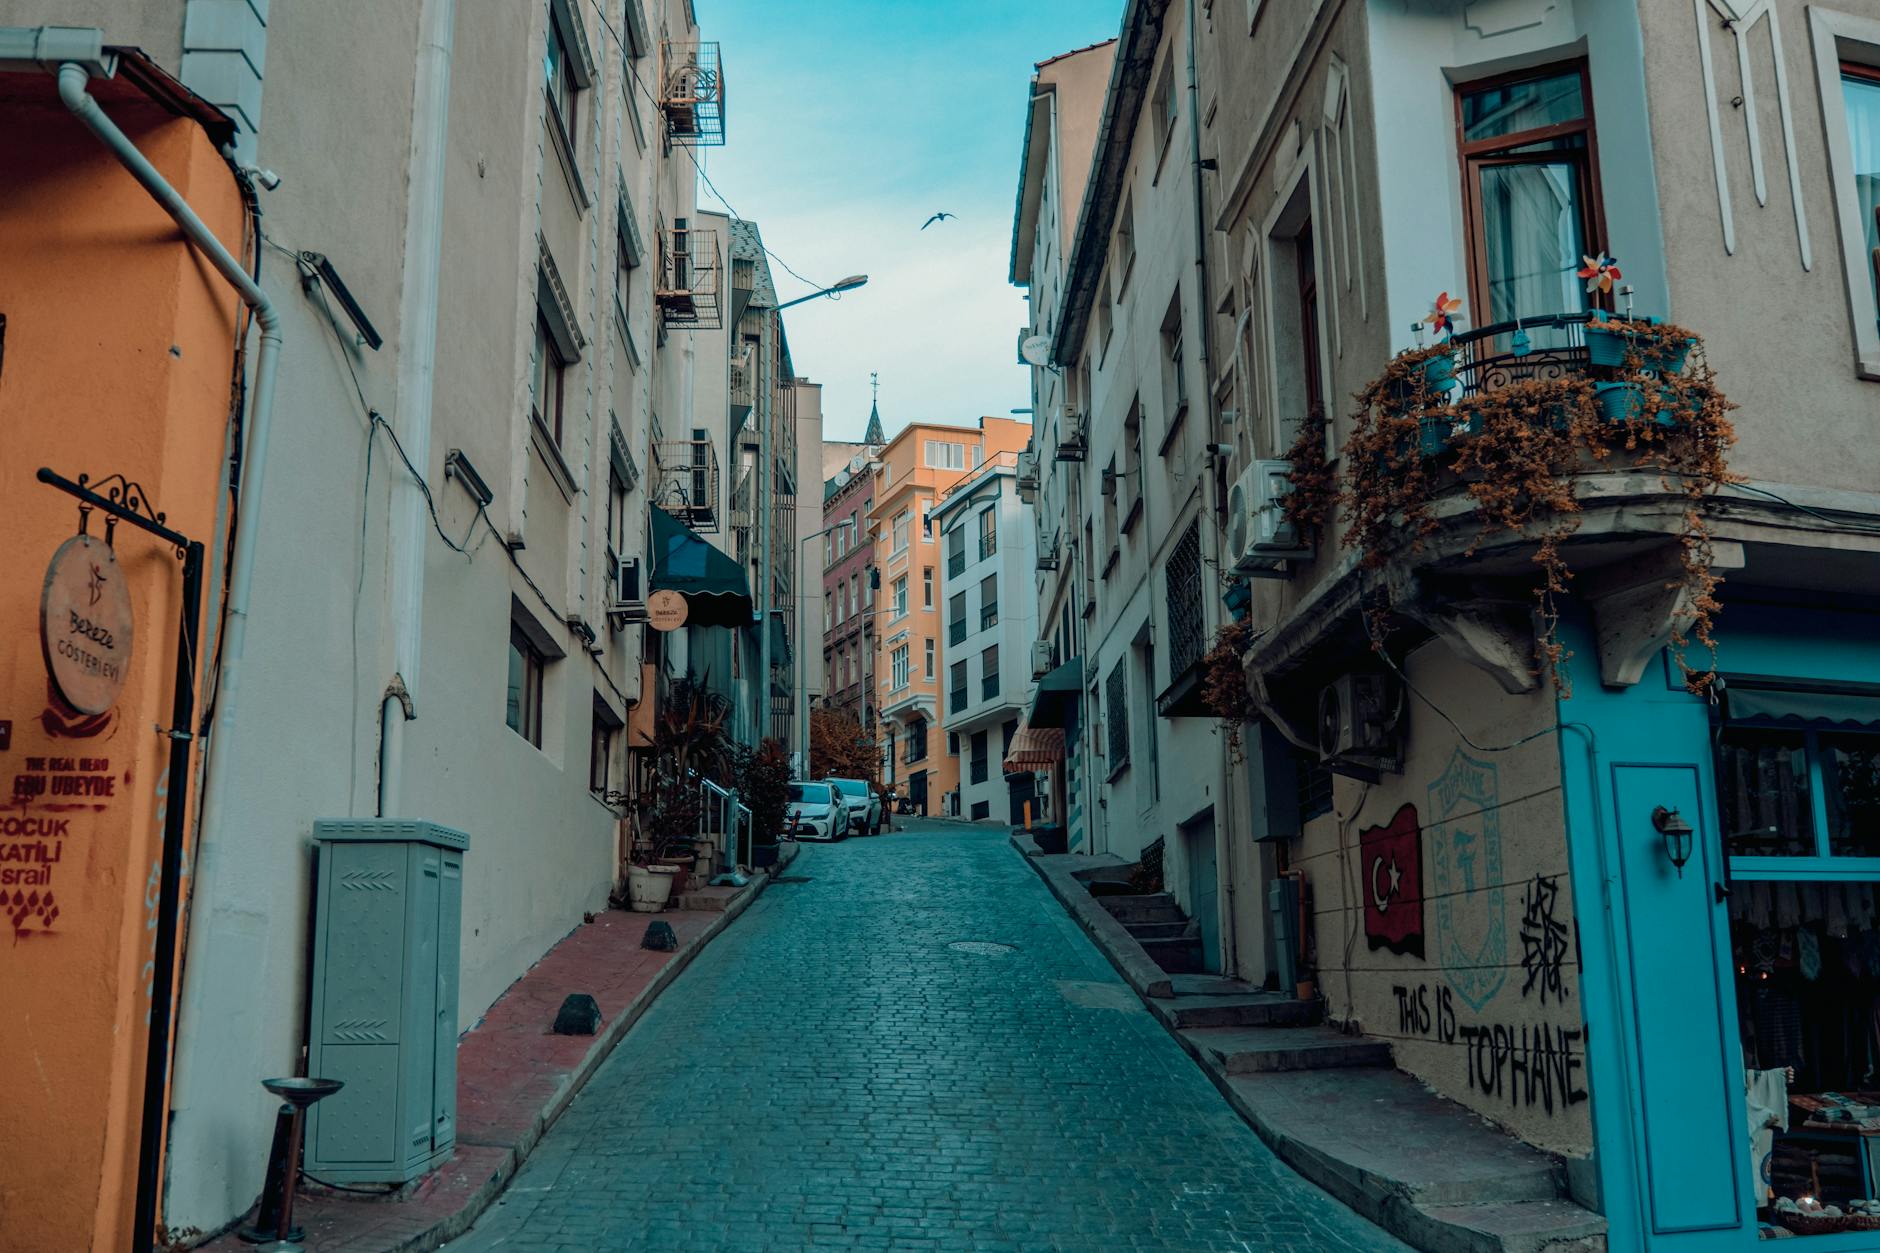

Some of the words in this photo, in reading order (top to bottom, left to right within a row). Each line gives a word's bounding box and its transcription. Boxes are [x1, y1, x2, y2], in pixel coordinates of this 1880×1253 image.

[25, 757, 46, 771] THE
[49, 757, 76, 771] REAL
[51, 775, 116, 797] UBEYDE
[0, 816, 70, 838] OCUK
[1393, 984, 1432, 1035] THIS
[1436, 984, 1456, 1045] IS
[1460, 1020, 1589, 1118] TOPHANE
